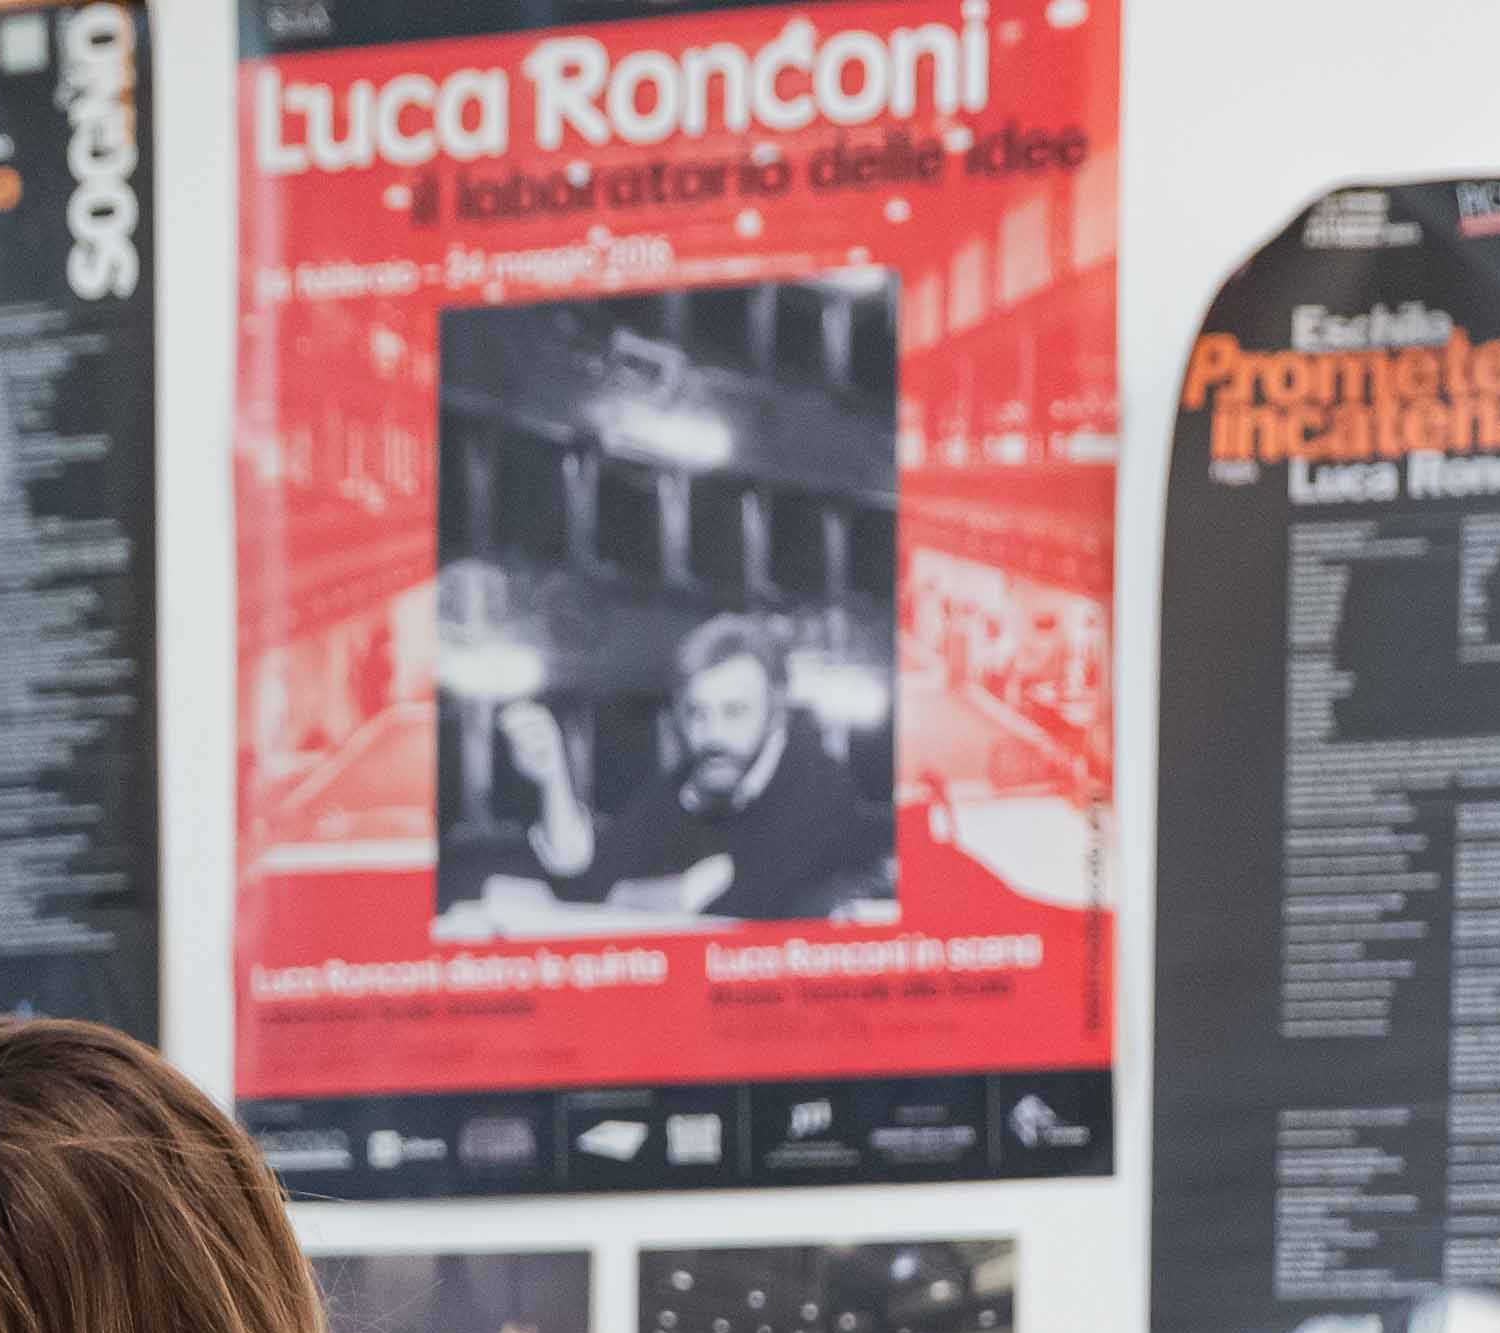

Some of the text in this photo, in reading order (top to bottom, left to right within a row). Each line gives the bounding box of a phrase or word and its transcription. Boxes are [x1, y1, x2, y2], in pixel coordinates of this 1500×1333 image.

[252, 0, 992, 176] Luca Ronconi
[808, 128, 944, 190] delle
